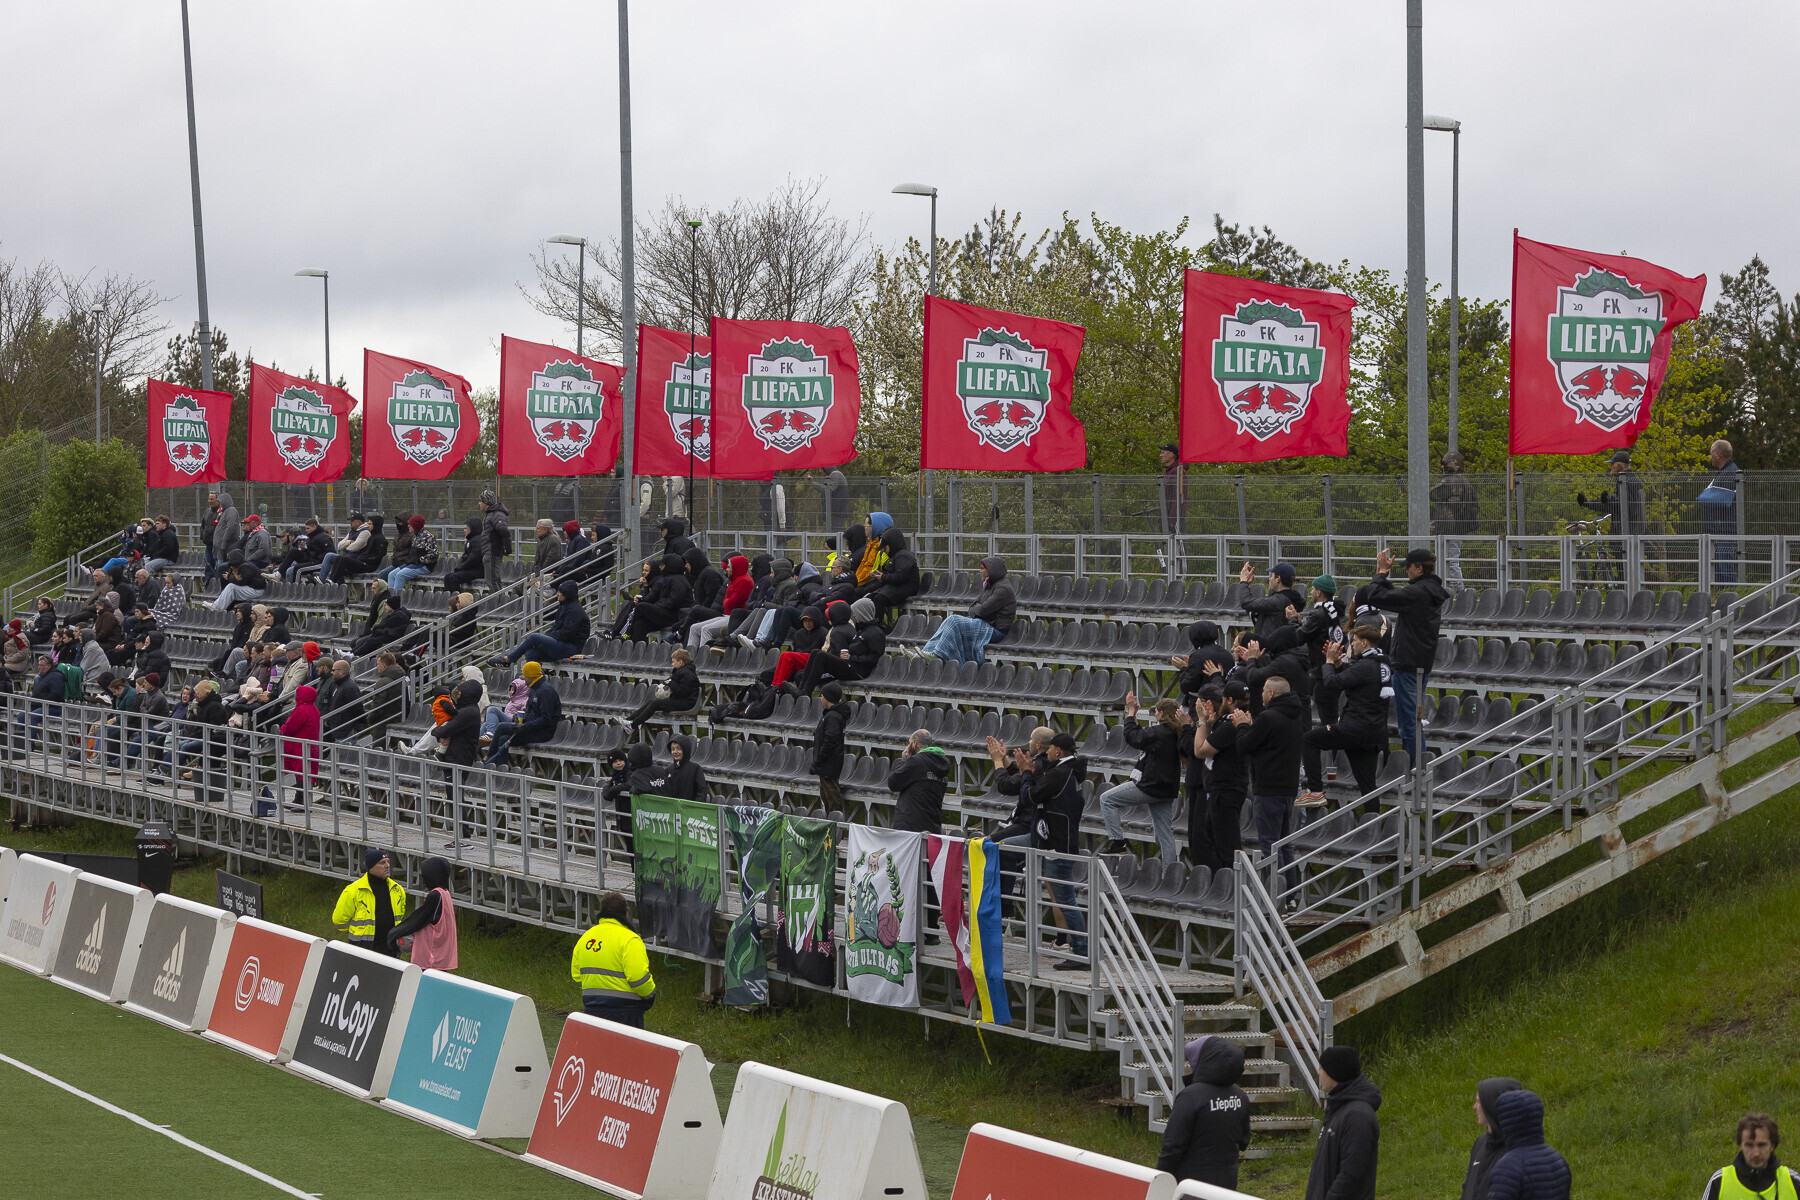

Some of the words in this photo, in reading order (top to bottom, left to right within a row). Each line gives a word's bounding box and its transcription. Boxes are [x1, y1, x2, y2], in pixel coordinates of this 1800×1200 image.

[1573, 303, 1583, 311] 20
[1603, 298, 1621, 314] FK
[1235, 329, 1246, 337] 20
[1260, 326, 1276, 341] FK
[1294, 334, 1304, 342] 14
[1561, 323, 1655, 354] LIEPĀJA
[1000, 347, 1013, 361] FK
[1224, 347, 1311, 376] LIEPĀJA
[704, 372, 711, 383] F
[760, 365, 769, 373] 20
[780, 362, 794, 374] FK
[561, 380, 573, 391] FK
[752, 380, 824, 402] LIEPĀJA
[966, 367, 1041, 395] LIEPĀJA
[420, 388, 431, 399] FK
[534, 394, 594, 415] LIEPĀJA
[673, 387, 711, 410] LIEP
[297, 401, 308, 411] FK
[395, 402, 455, 423] LIEPĀJA
[167, 422, 207, 439] LIEPĀJA
[277, 412, 329, 435] LIEPĀJA
[75, 946, 101, 975] adidas
[860, 948, 899, 976] ULTRAS
[153, 971, 181, 1003] adidas
[257, 976, 285, 1007] STADIONI
[320, 971, 379, 1062] inCopy
[452, 1015, 482, 1045] TONUS
[443, 1043, 473, 1072] ELAST
[591, 1069, 622, 1103] SPORTA
[619, 1078, 660, 1115] VESELĪBAS
[1210, 1096, 1242, 1112] Liepāja
[597, 1115, 630, 1149] CENTRS
